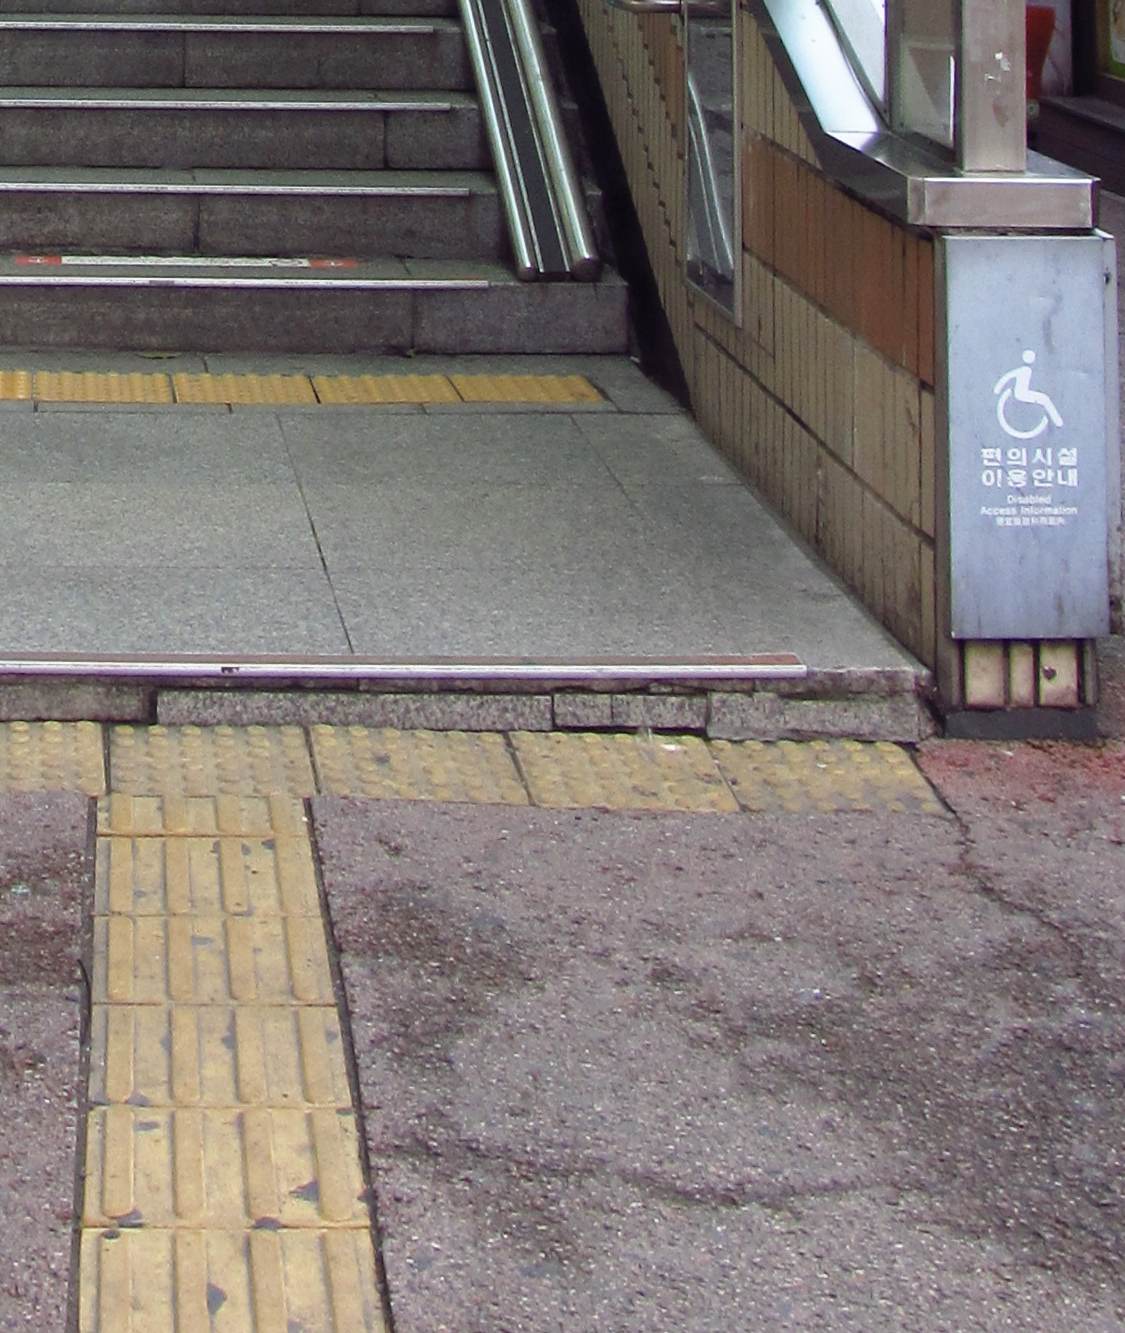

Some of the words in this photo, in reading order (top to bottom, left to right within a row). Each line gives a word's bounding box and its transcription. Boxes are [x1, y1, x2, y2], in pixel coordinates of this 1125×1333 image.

[980, 447, 1078, 466] 편의시설
[981, 469, 1078, 488] 이용안내
[1021, 506, 1078, 515] Information
